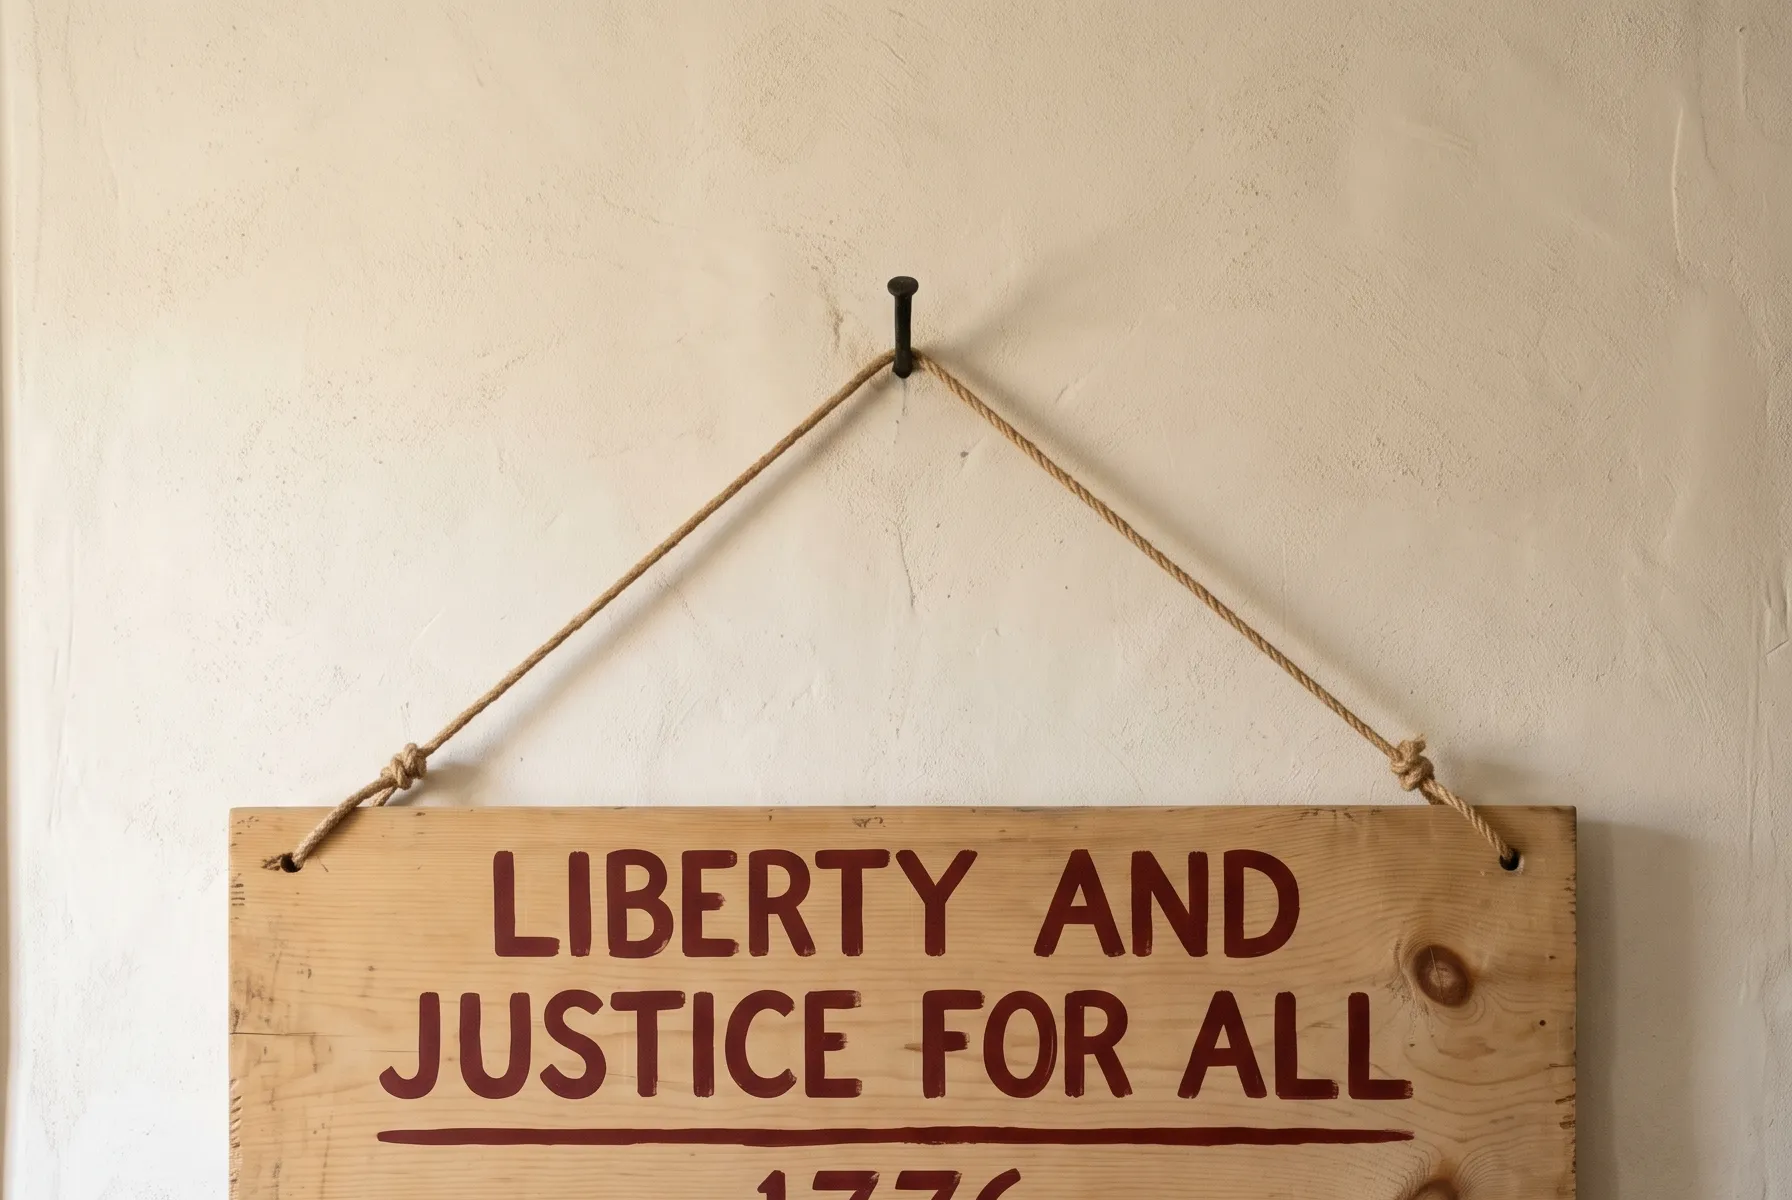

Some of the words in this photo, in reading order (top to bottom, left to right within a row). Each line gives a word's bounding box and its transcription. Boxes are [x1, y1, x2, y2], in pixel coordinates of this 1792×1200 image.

[492, 848, 979, 959] LIBERTY
[1033, 848, 1301, 959] AND
[378, 989, 863, 1100] JUSTICE
[921, 989, 1134, 1100] FOR
[1177, 990, 1414, 1101] ALL
